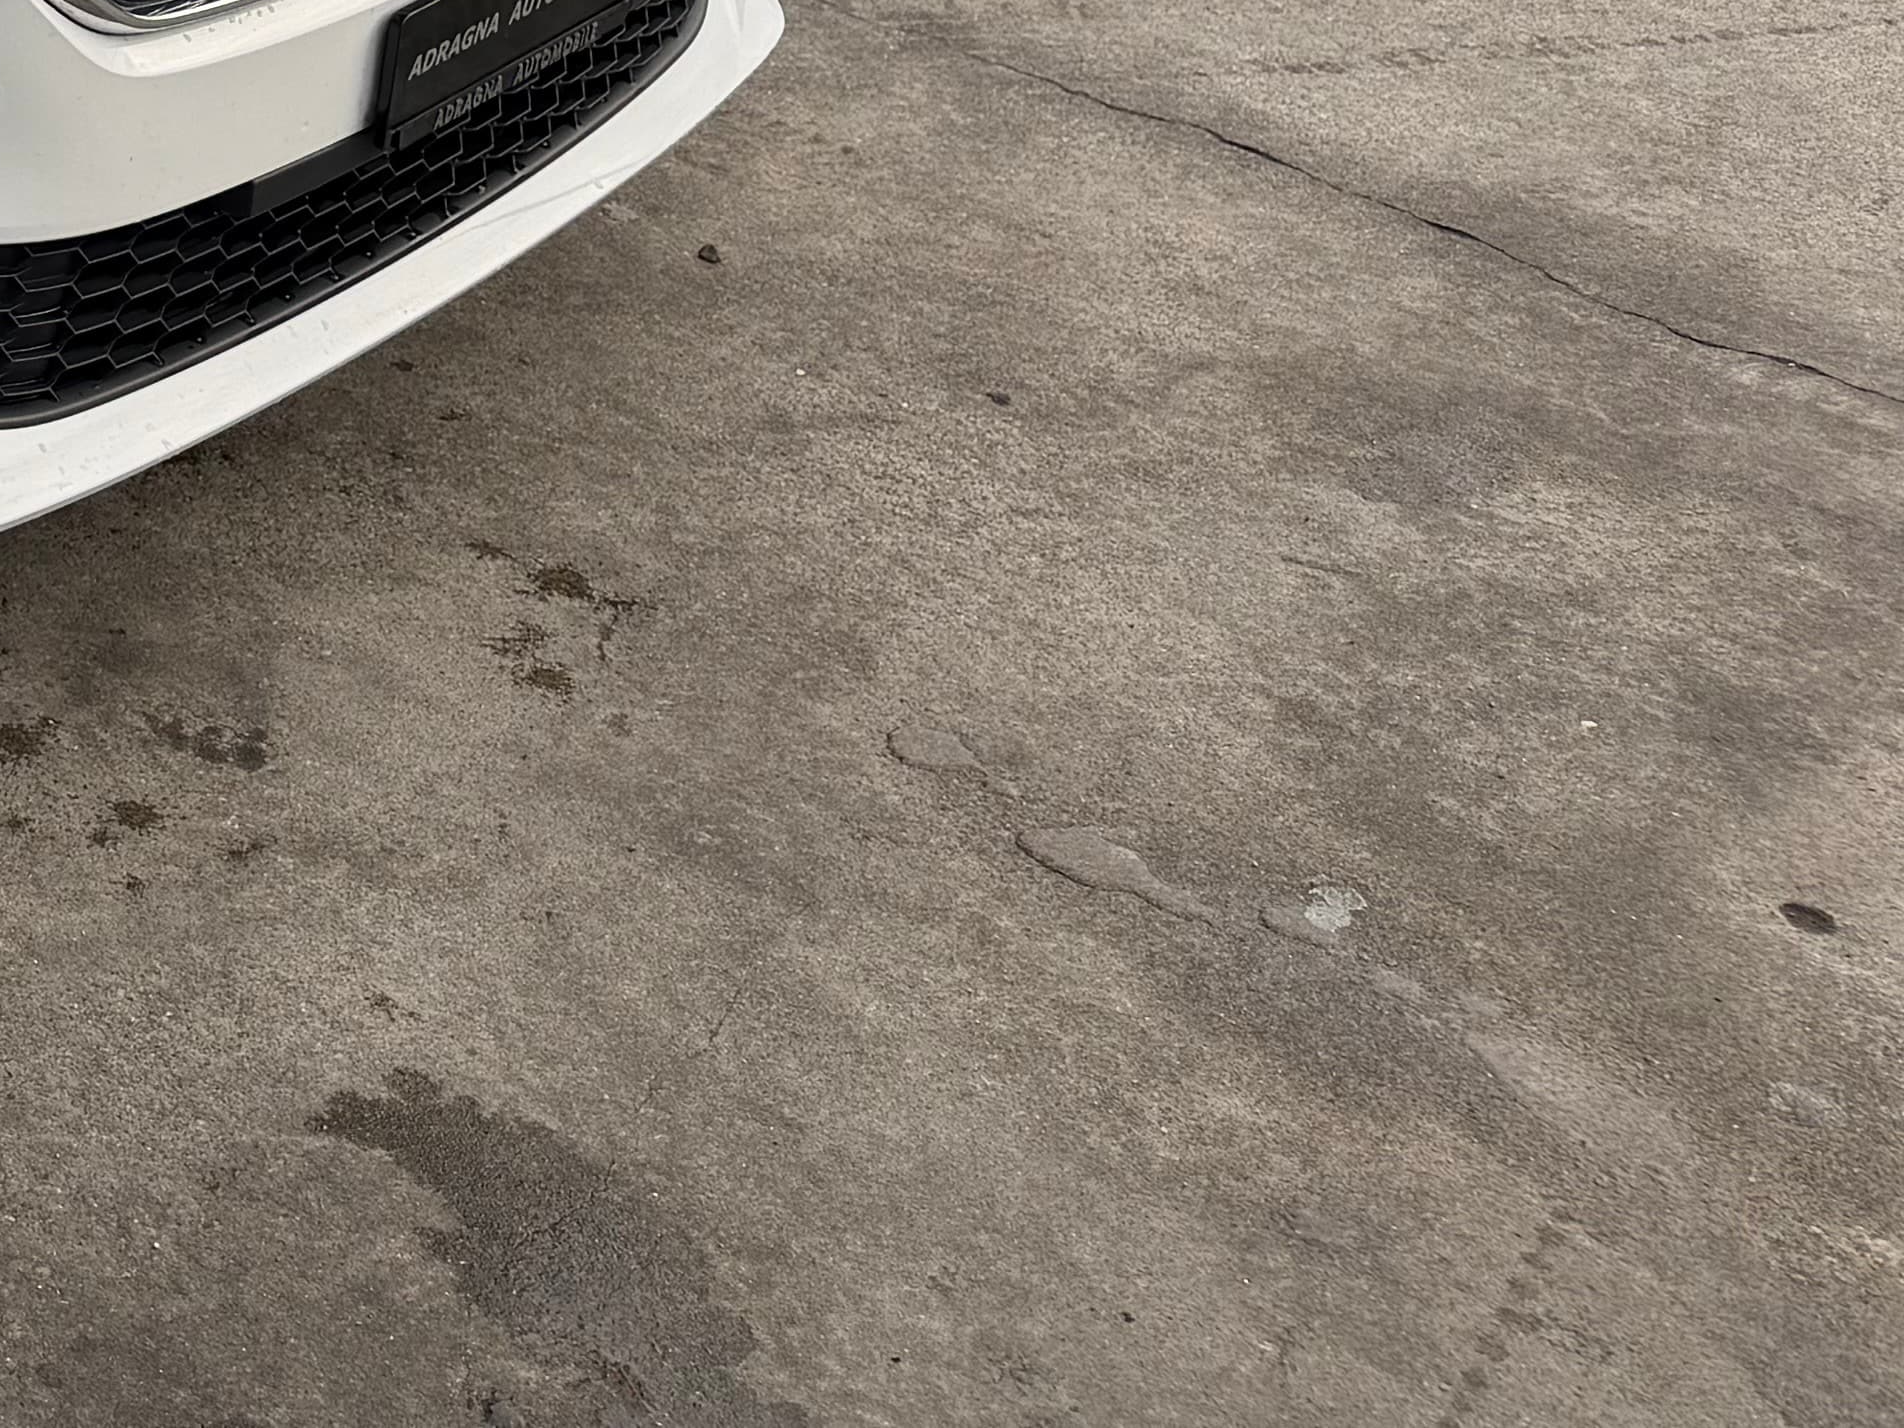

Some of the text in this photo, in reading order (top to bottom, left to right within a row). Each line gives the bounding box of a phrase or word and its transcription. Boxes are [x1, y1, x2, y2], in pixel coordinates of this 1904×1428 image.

[408, 12, 499, 81] ADRAGNA
[434, 22, 598, 130] ADRAGNA AUTOMOBILE
